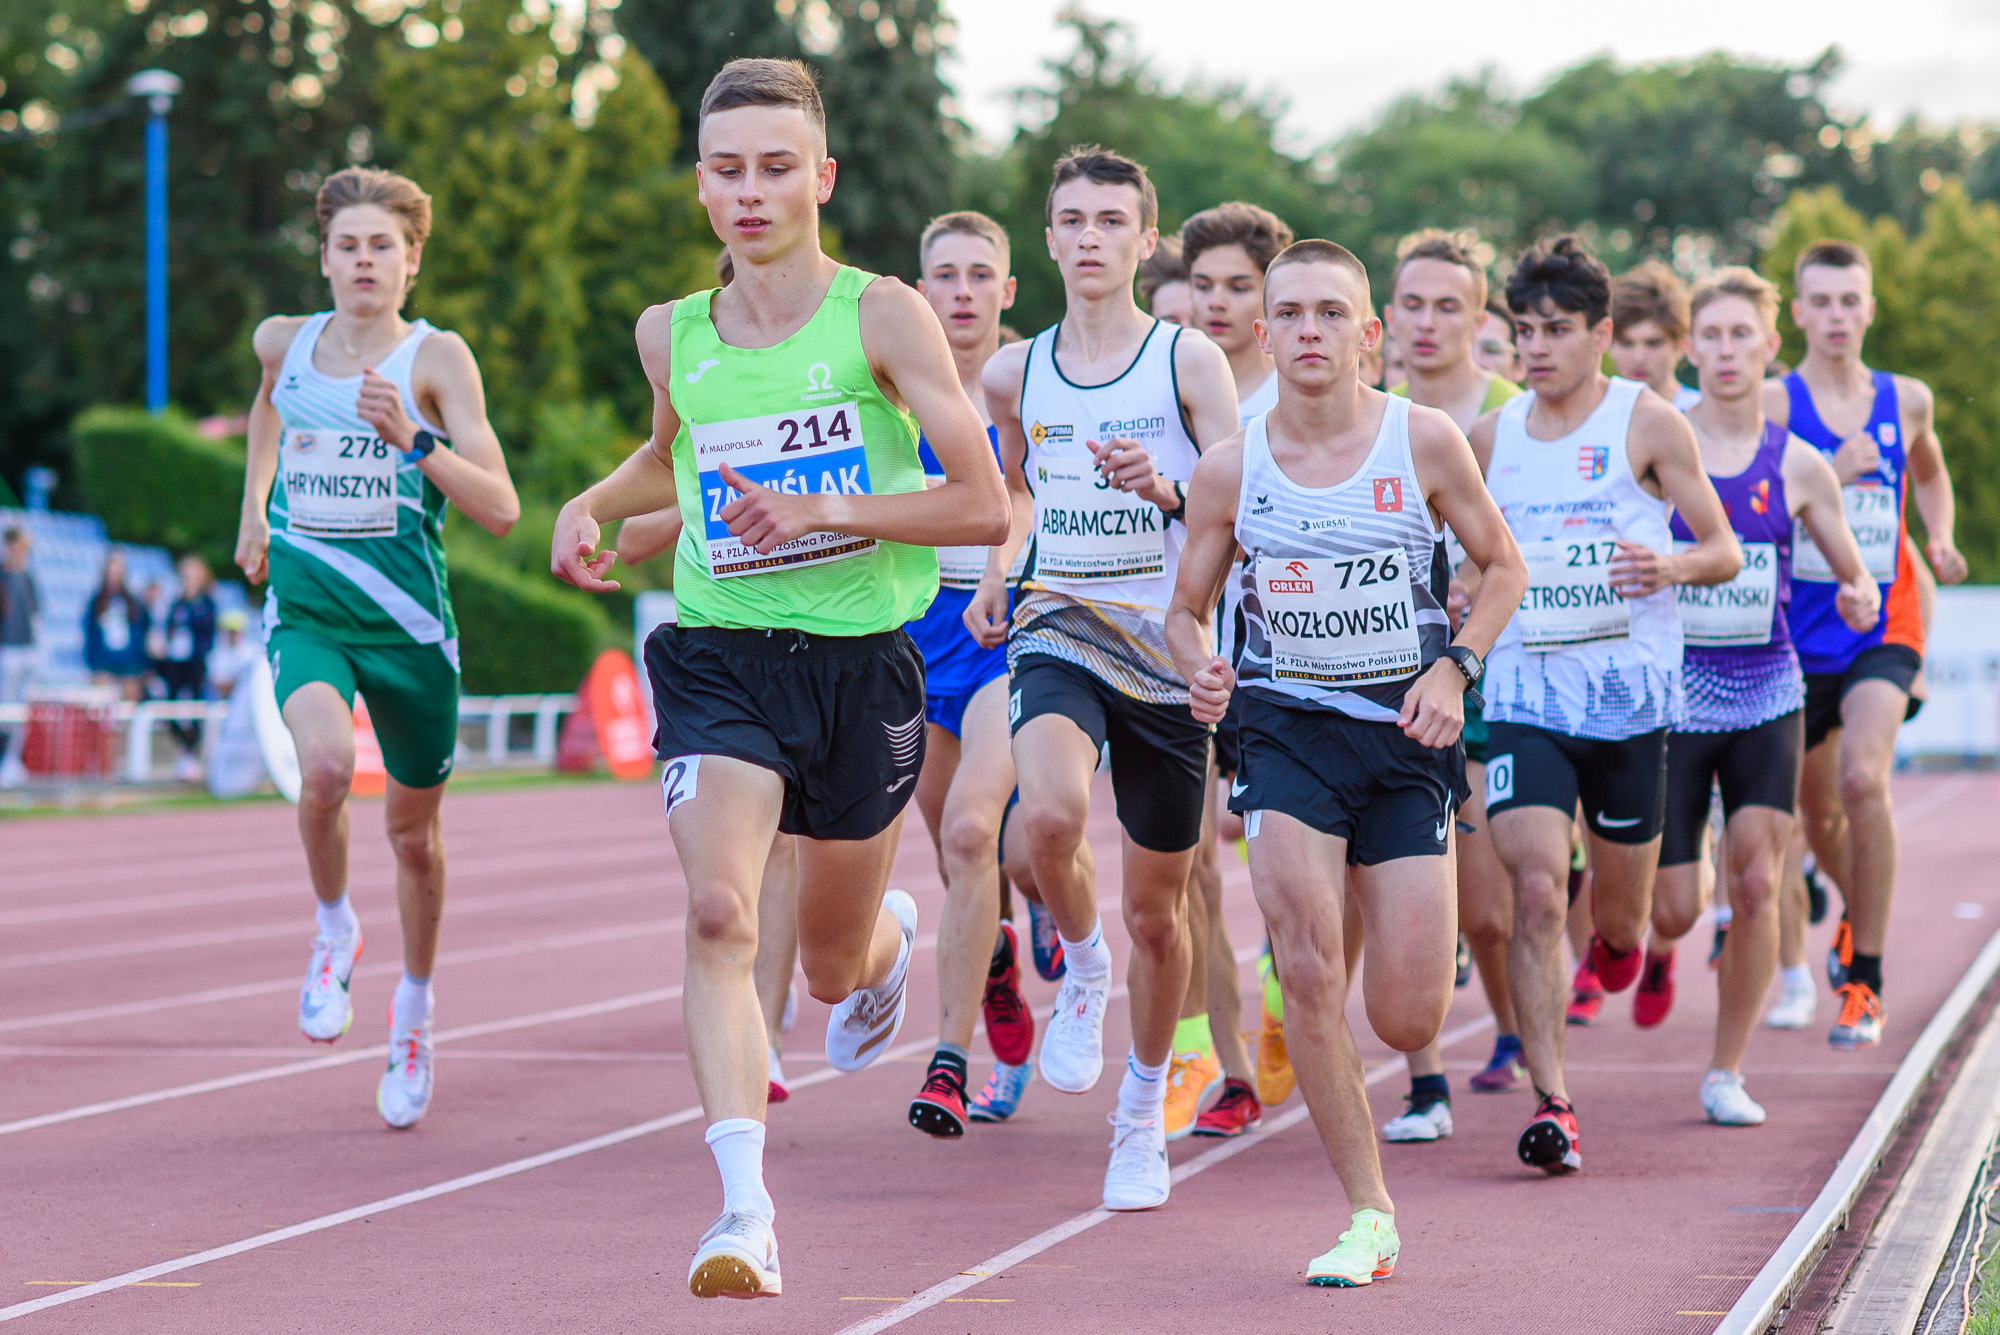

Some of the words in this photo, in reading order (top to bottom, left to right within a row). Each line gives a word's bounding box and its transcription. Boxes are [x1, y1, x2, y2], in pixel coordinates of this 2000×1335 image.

[777, 409, 852, 453] 214
[1047, 426, 1073, 437] OPTIMA
[338, 436, 388, 460] 278
[709, 438, 763, 454] MAŁOPOLSKA
[287, 471, 391, 498] HRYNISZYN
[1041, 506, 1156, 537] ABRAMCZYK
[1252, 505, 1274, 516] erima
[1525, 504, 1551, 517] PKP
[1553, 500, 1616, 514] INTERCITY
[1312, 518, 1347, 530] WERSAL
[711, 550, 725, 561] 54.
[726, 546, 750, 559] PZLA
[820, 532, 852, 544] Polsk
[715, 558, 784, 574] BIELSKO-BIAŁA
[802, 539, 874, 560] 15-17.07.2022
[1566, 541, 1615, 568] 217
[1065, 559, 1114, 568] Mistrzostwa
[1116, 556, 1144, 567] Polski
[1334, 554, 1400, 590] 726
[1271, 581, 1312, 593] ORLEN
[1519, 584, 1624, 611] ETROSYAN
[1672, 581, 1769, 608] ARZYŃSKI
[1267, 601, 1410, 639] KOZŁOWSKI
[1275, 656, 1289, 666] 54.
[1290, 657, 1310, 668] PZLA
[1311, 660, 1366, 671] Mistrzostwa
[1368, 654, 1397, 667] Polski
[1400, 652, 1419, 662] U18
[1277, 670, 1337, 682] BIELSKO-BIAŁA
[664, 761, 686, 815] 2
